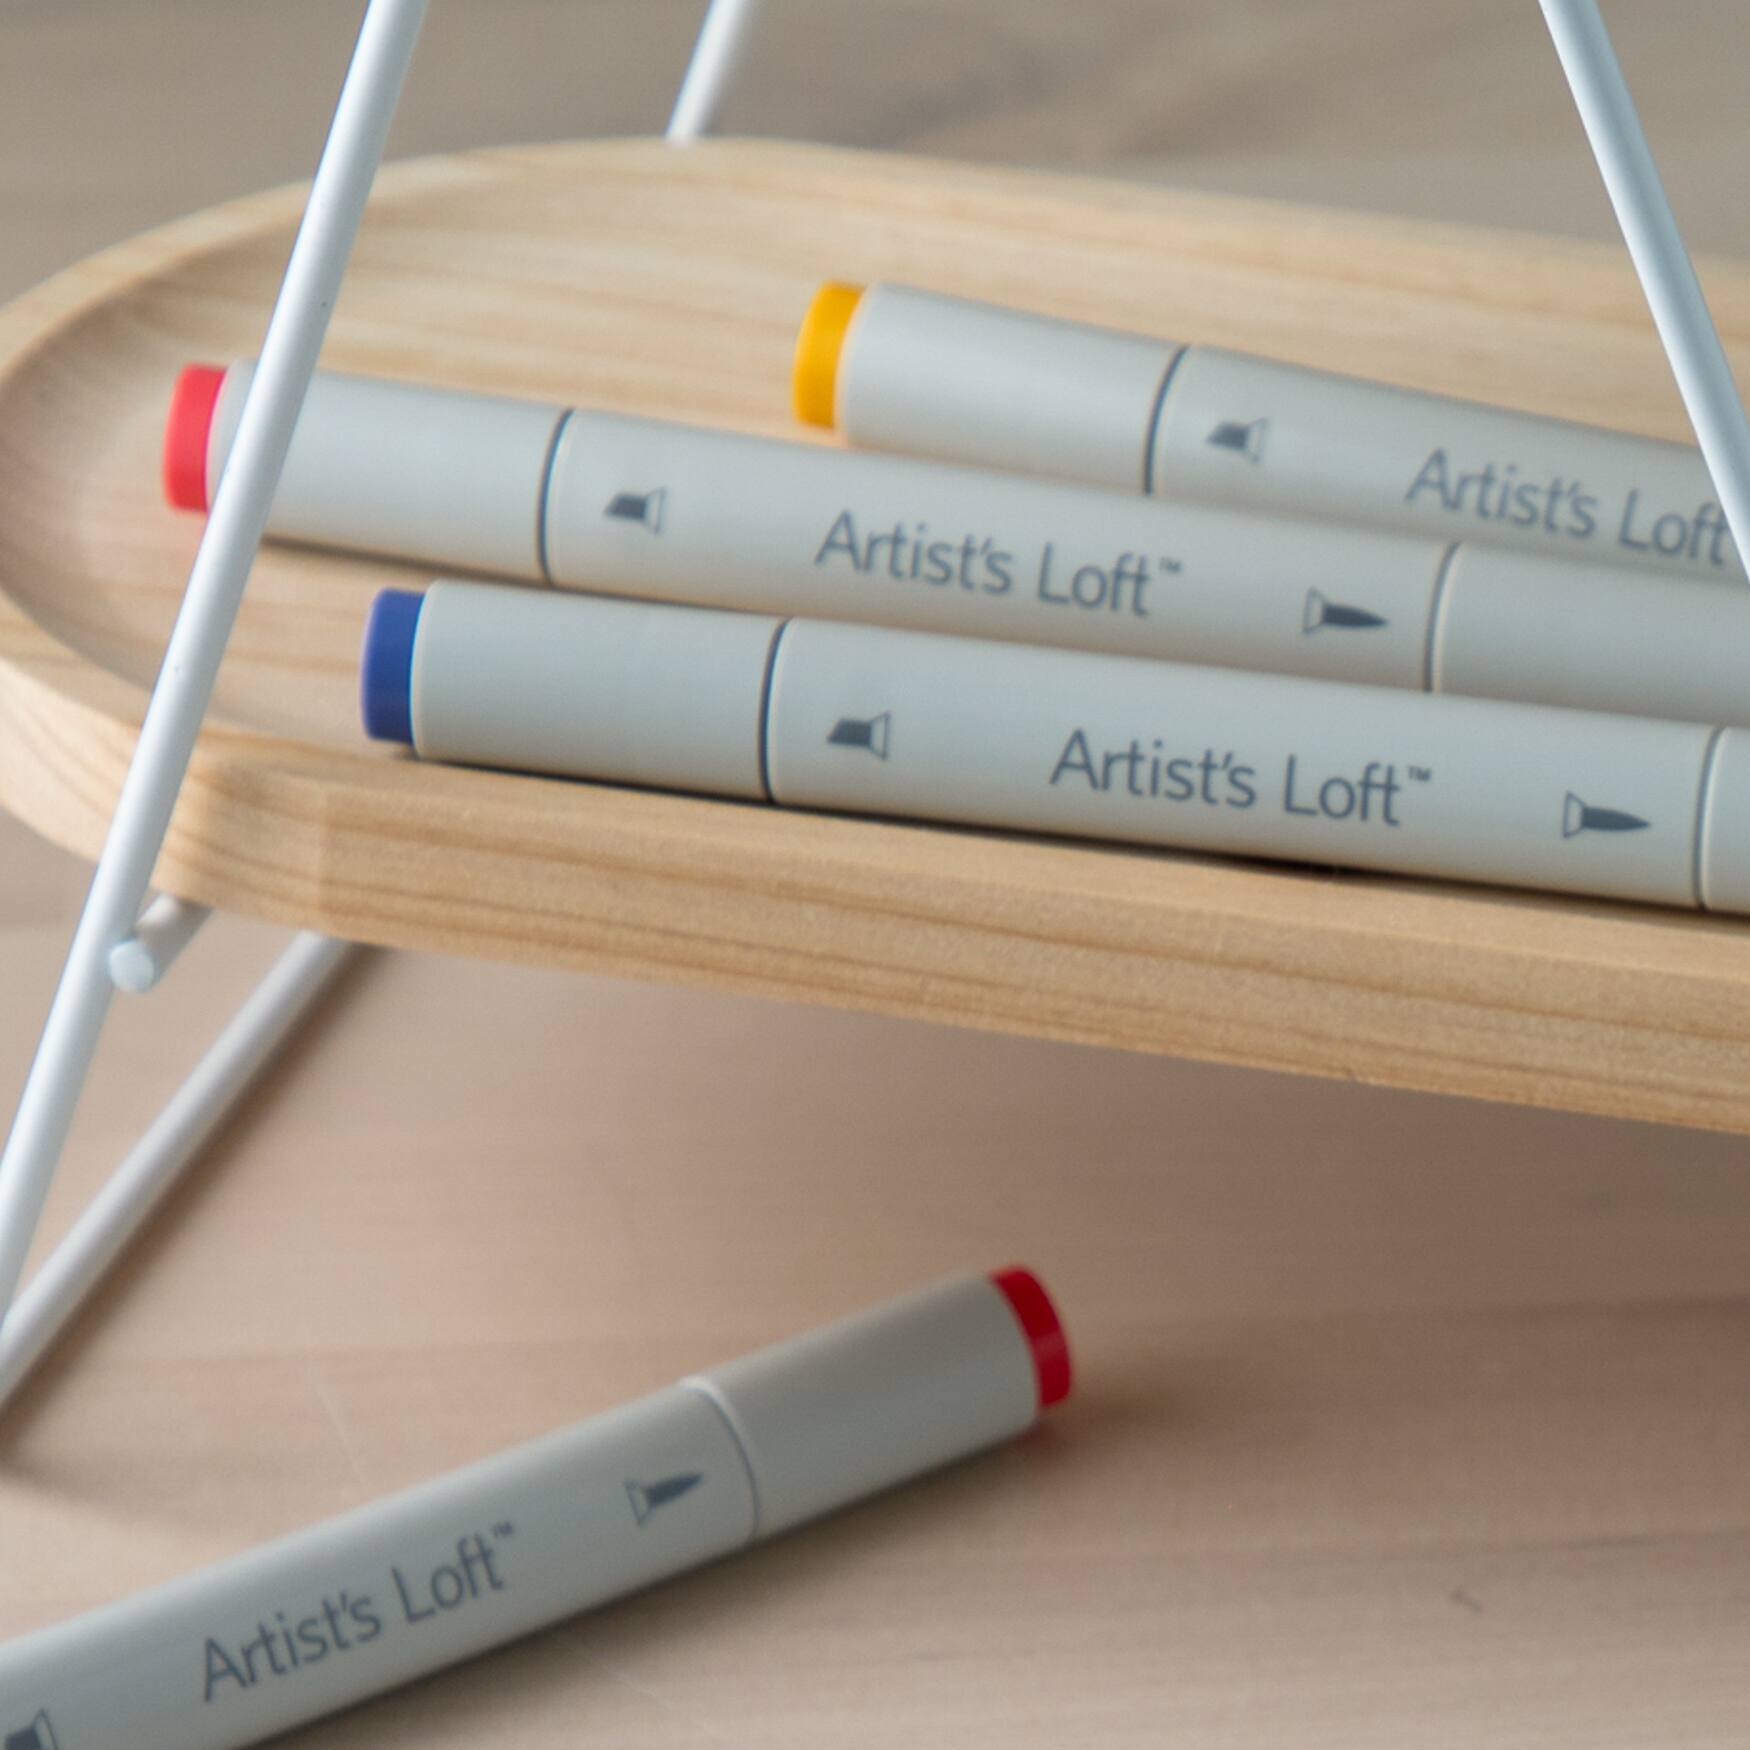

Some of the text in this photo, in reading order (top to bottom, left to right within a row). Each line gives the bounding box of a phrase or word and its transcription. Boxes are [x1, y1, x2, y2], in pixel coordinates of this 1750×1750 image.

[1404, 446, 1597, 540] Artist's
[814, 508, 1013, 595] Artist's
[1049, 727, 1257, 810] Artist's
[204, 1590, 382, 1702] Artist's
